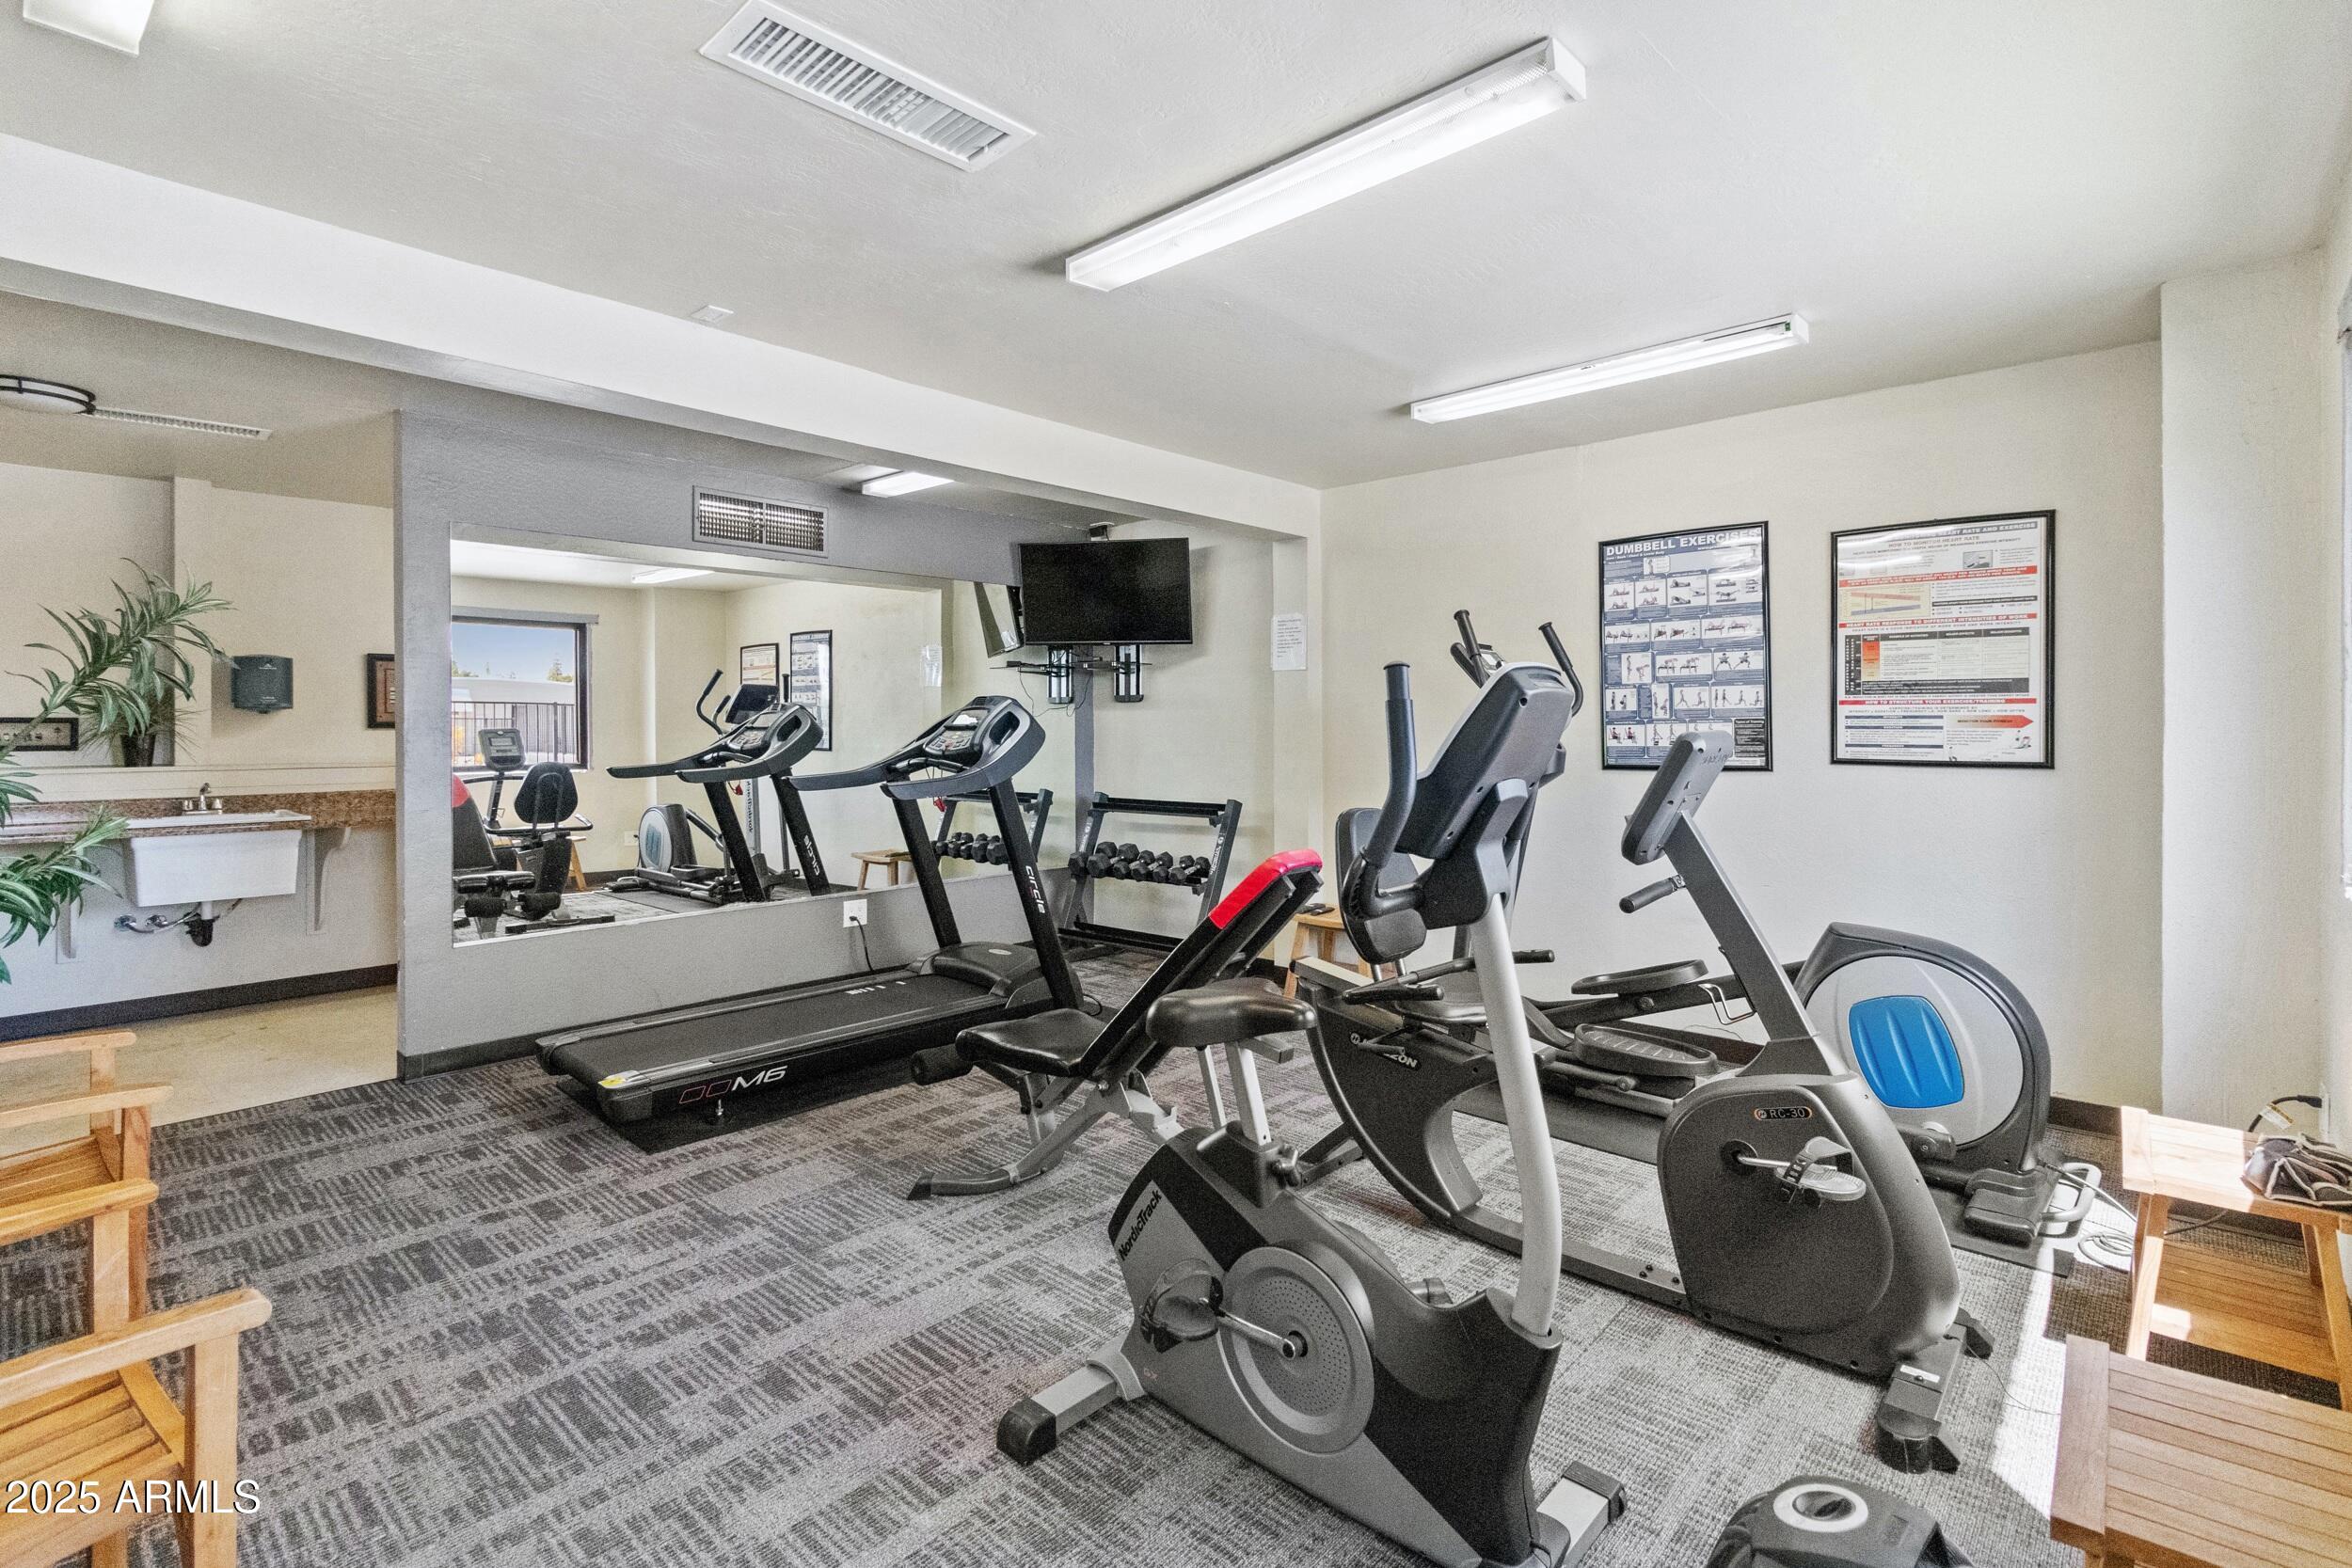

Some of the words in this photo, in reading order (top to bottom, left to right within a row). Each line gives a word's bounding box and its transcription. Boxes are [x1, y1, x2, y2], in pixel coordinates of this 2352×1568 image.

[1999, 522, 2036, 531] EXERCISE
[1605, 540, 1676, 556] DUMBBELL
[1679, 528, 1762, 547] EXERCISES
[1770, 1108, 1805, 1118] RC-30
[1119, 1190, 1162, 1260] NordicTrack
